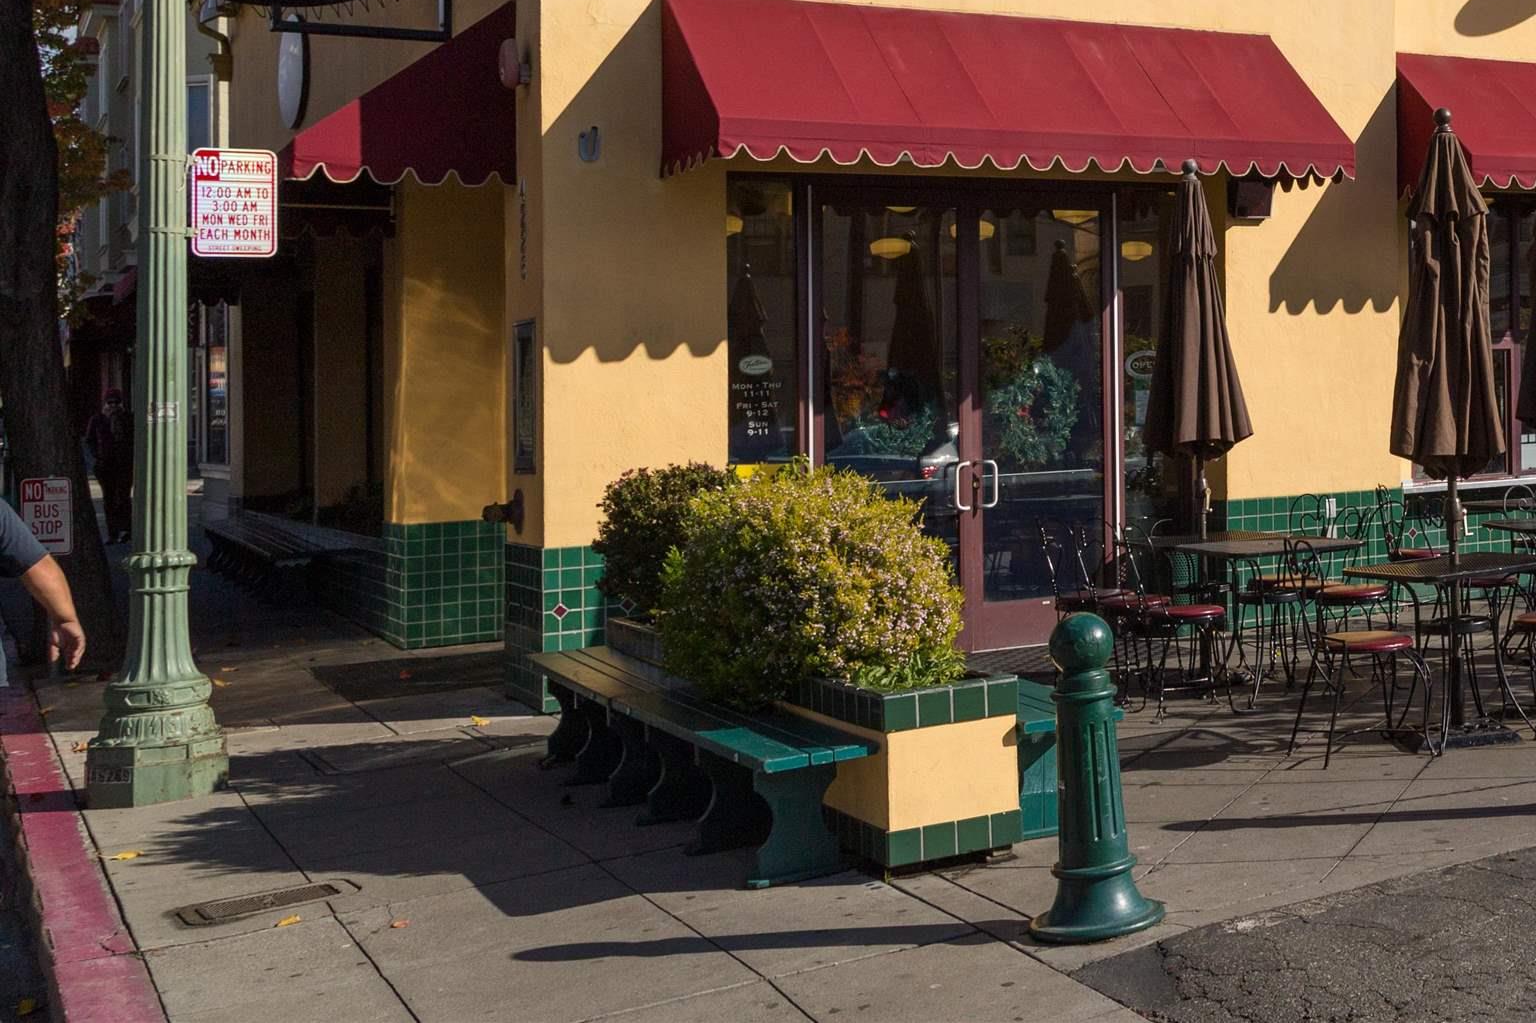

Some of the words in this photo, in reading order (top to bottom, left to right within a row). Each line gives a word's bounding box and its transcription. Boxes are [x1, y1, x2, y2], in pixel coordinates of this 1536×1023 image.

[197, 156, 218, 176] NO
[221, 160, 271, 175] PARKING
[202, 187, 232, 198] 12:00
[236, 187, 252, 198] AM
[256, 188, 269, 199] TO
[213, 201, 238, 212] 3:00
[242, 201, 257, 212] AM
[202, 214, 223, 225] MON
[228, 215, 248, 226] WED
[253, 215, 268, 226] FRI
[200, 228, 228, 240] EACH
[234, 229, 271, 240] MONTH
[25, 482, 42, 500] NO
[34, 504, 60, 518] BUS
[32, 520, 63, 535] STOP
